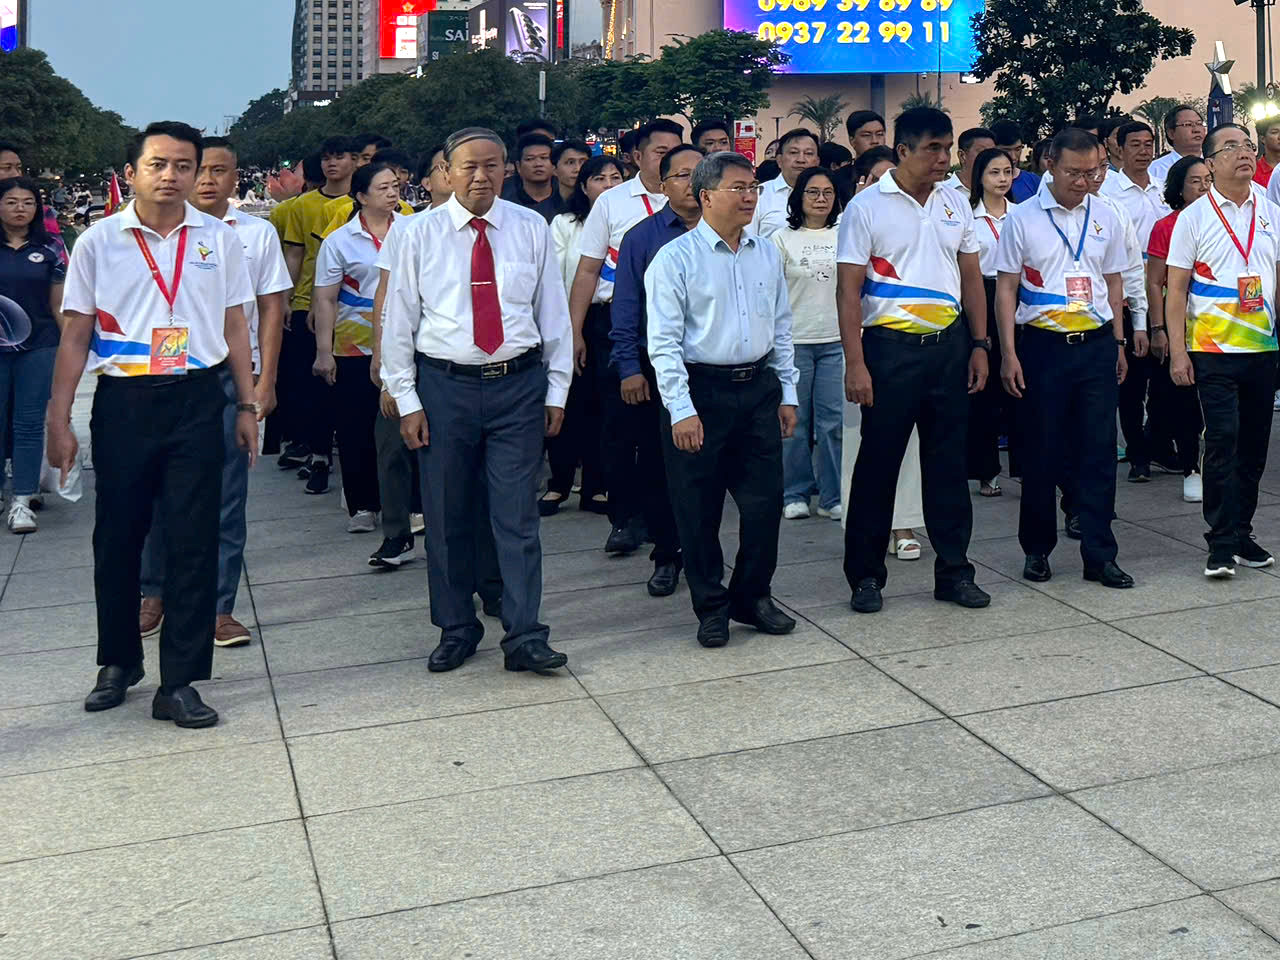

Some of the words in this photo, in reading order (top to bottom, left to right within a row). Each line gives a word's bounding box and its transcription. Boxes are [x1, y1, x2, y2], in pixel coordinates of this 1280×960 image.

[757, 21, 827, 44] 0937
[837, 21, 870, 43] 22
[878, 21, 913, 43] 99
[922, 22, 950, 43] 11
